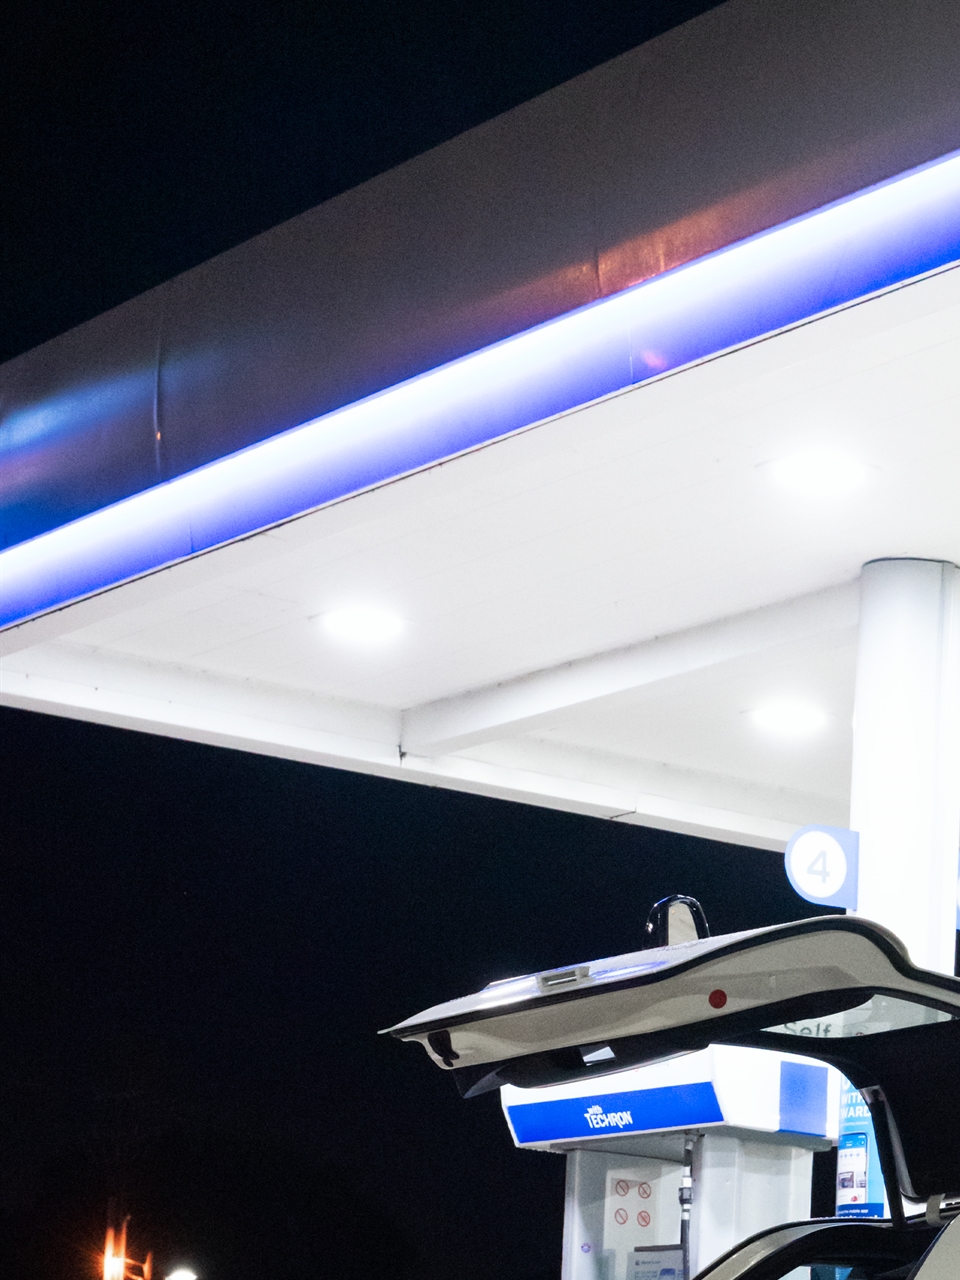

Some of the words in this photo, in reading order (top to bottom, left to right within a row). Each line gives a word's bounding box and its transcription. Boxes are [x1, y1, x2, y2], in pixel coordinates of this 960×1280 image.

[807, 850, 830, 883] 4
[784, 1022, 832, 1037] Self
[587, 1105, 603, 1114] with
[584, 1111, 633, 1128] TECHRON
